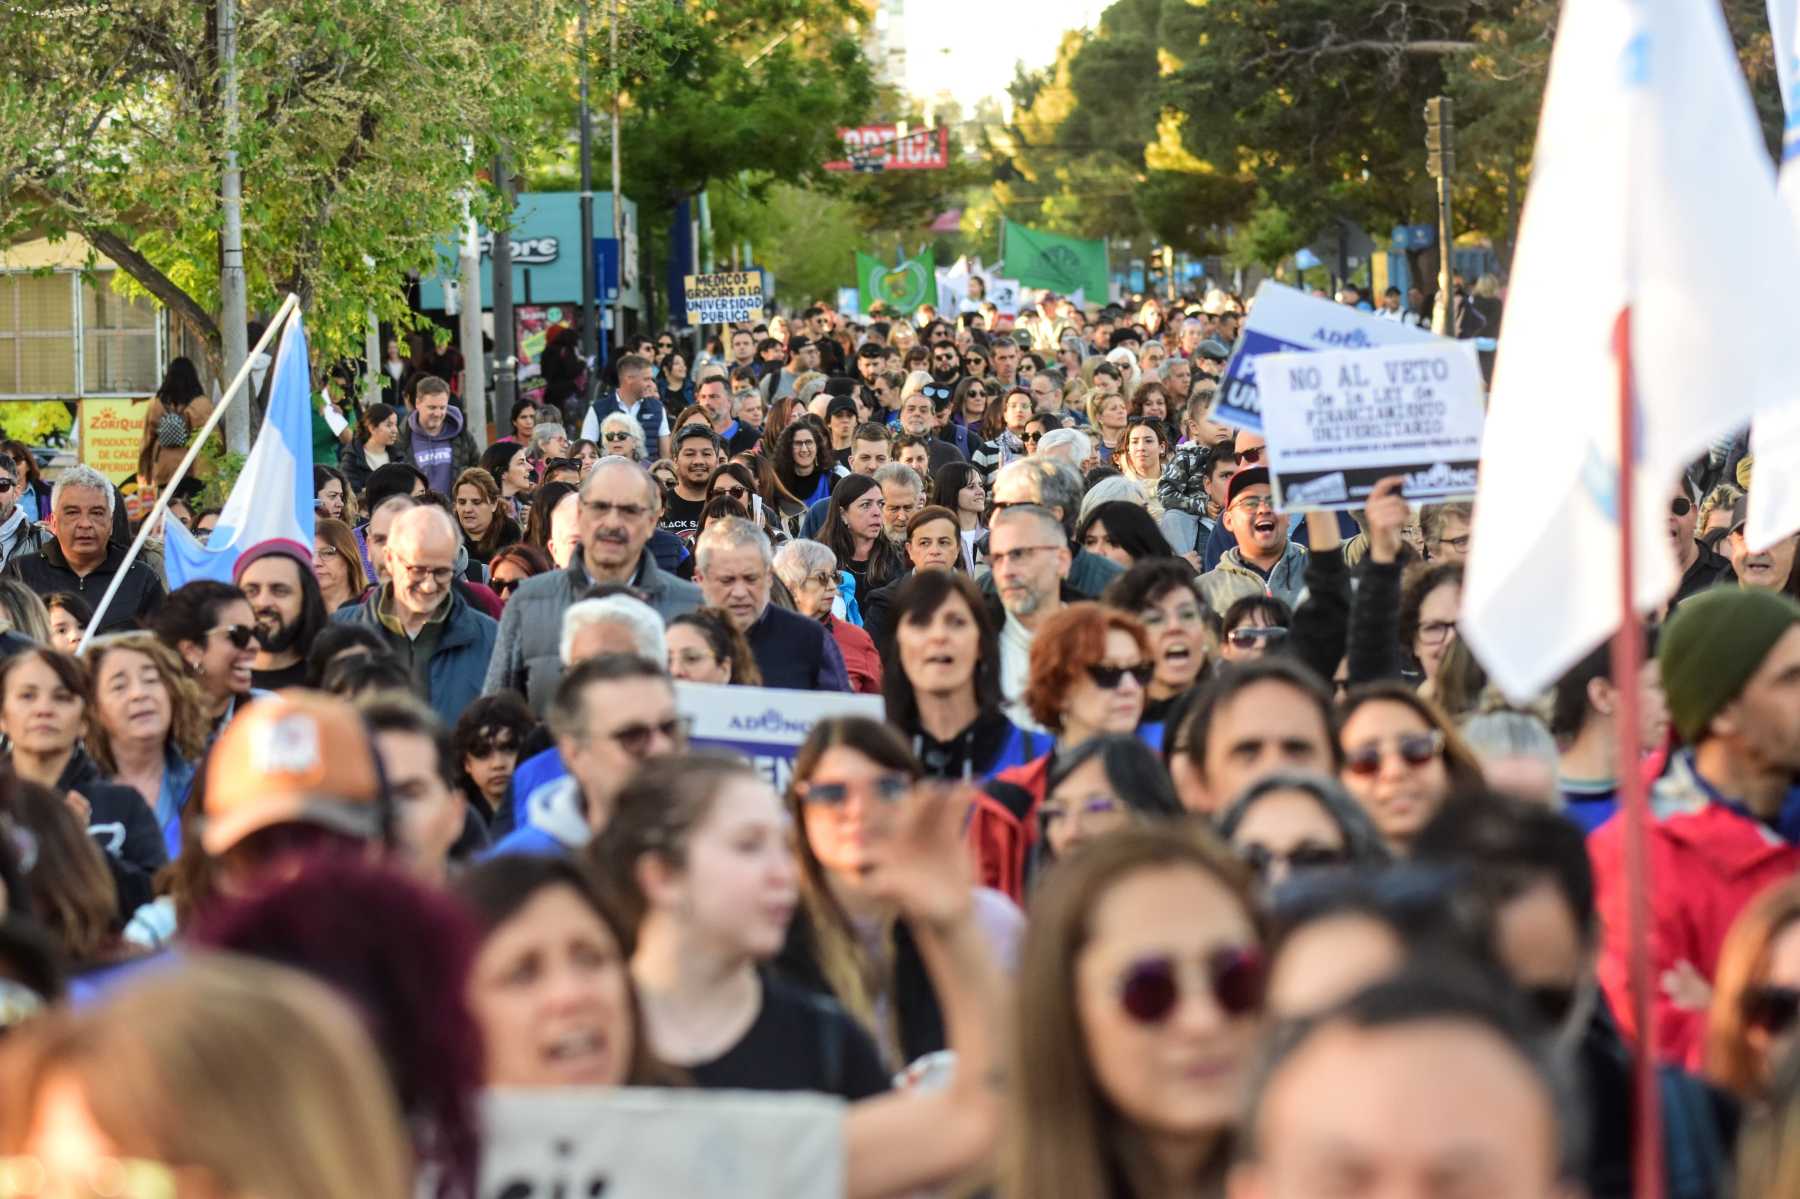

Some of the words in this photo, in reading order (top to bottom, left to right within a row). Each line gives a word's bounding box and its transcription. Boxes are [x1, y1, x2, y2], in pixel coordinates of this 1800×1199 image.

[696, 273, 748, 287] MEDICOS
[688, 287, 734, 299] GRACIAS
[739, 287, 746, 296] A
[748, 286, 760, 295] LA
[687, 297, 762, 311] UNIVERSIDAD
[701, 310, 749, 321] PUBLICA
[1289, 367, 1322, 391] NO
[1339, 363, 1369, 387] AL
[1385, 358, 1448, 384] VETO
[1313, 391, 1333, 406] de
[1345, 391, 1363, 404] la
[1374, 388, 1402, 403] LEY
[1415, 386, 1434, 400] de
[1306, 401, 1446, 426] FINANCIAMIENTO
[1312, 420, 1443, 442] UNIVERSITARIO
[92, 437, 141, 447] PRODUCTO
[98, 450, 109, 459] DE
